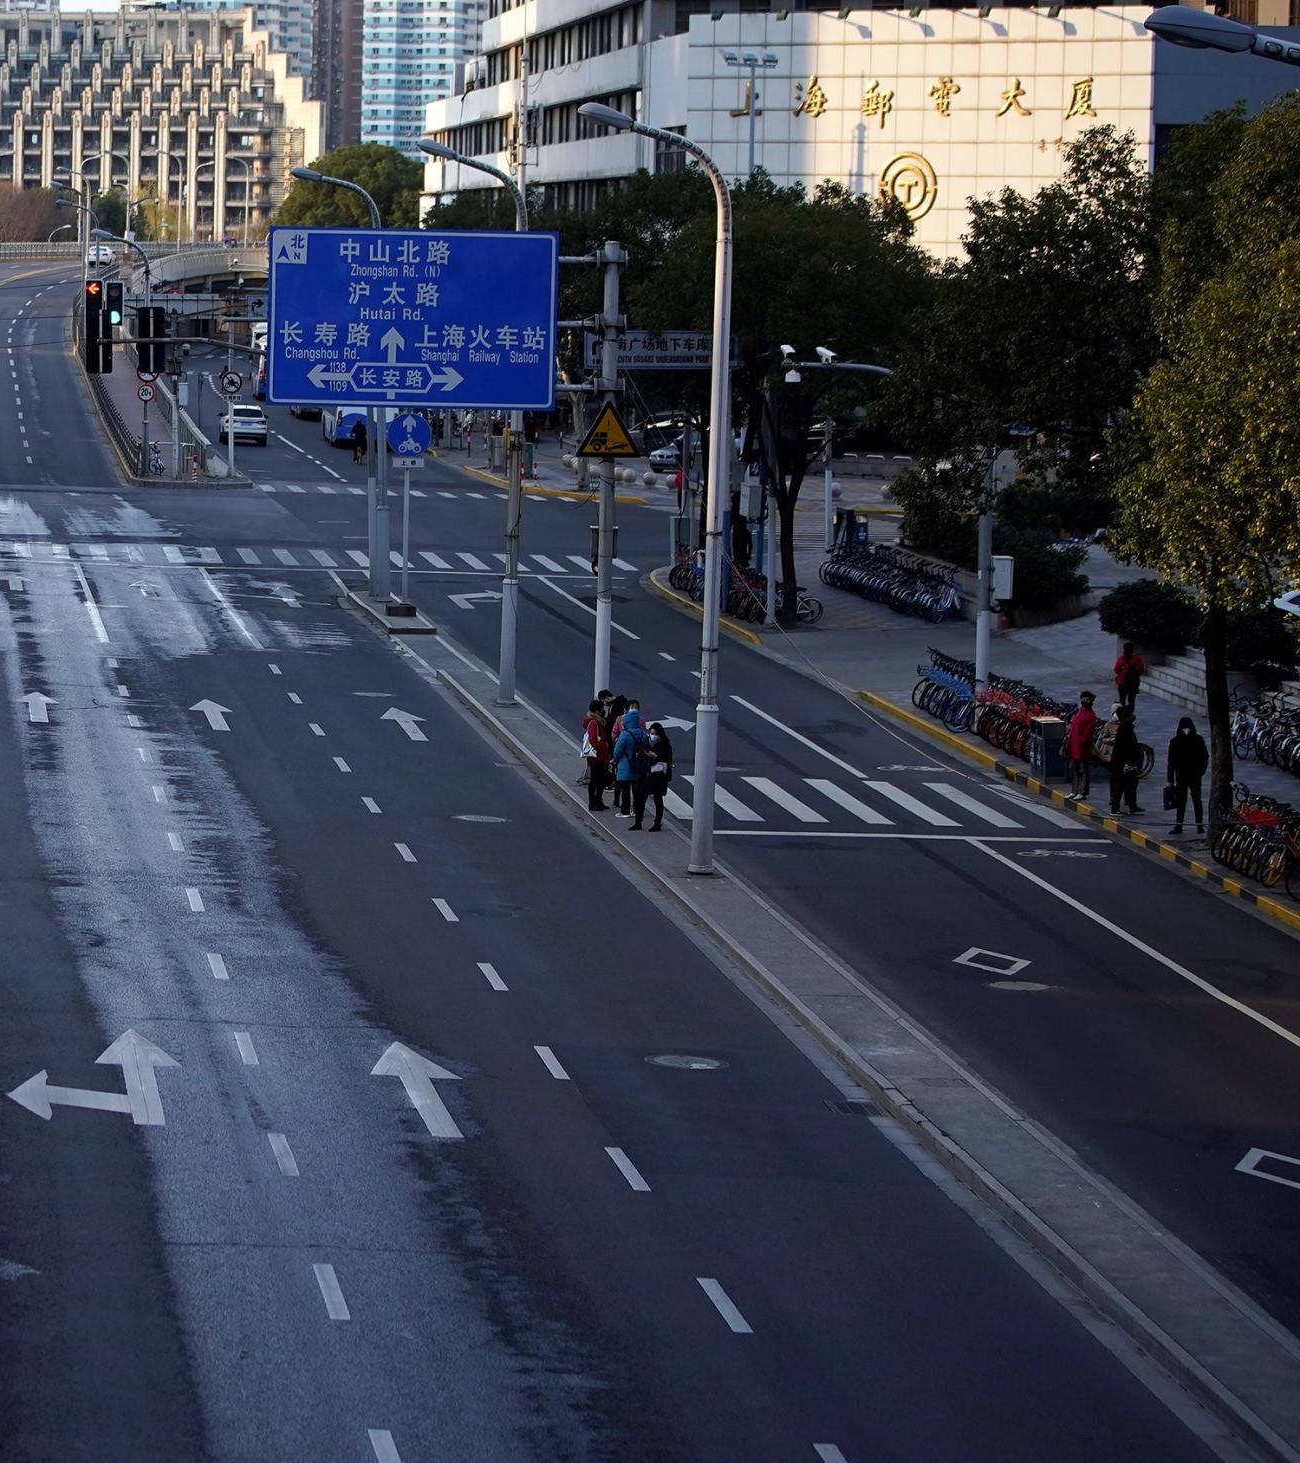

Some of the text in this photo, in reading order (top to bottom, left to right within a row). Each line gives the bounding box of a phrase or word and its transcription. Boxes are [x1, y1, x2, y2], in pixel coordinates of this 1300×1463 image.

[291, 234, 305, 249] 北
[294, 252, 301, 260] N
[339, 238, 452, 265] 中山北路
[350, 264, 441, 279] Zhongshan Rd. (N)
[348, 281, 441, 308] 沪太路
[360, 308, 425, 321] Hutai Rd.
[280, 320, 371, 348] 长寿路
[414, 324, 547, 351] 上海火车站
[285, 346, 360, 361] Changshou Rd.
[421, 350, 539, 366] Shanghai Railway Station
[329, 362, 347, 373] 1138
[359, 368, 423, 388] 长安路
[329, 380, 348, 392] 1109
